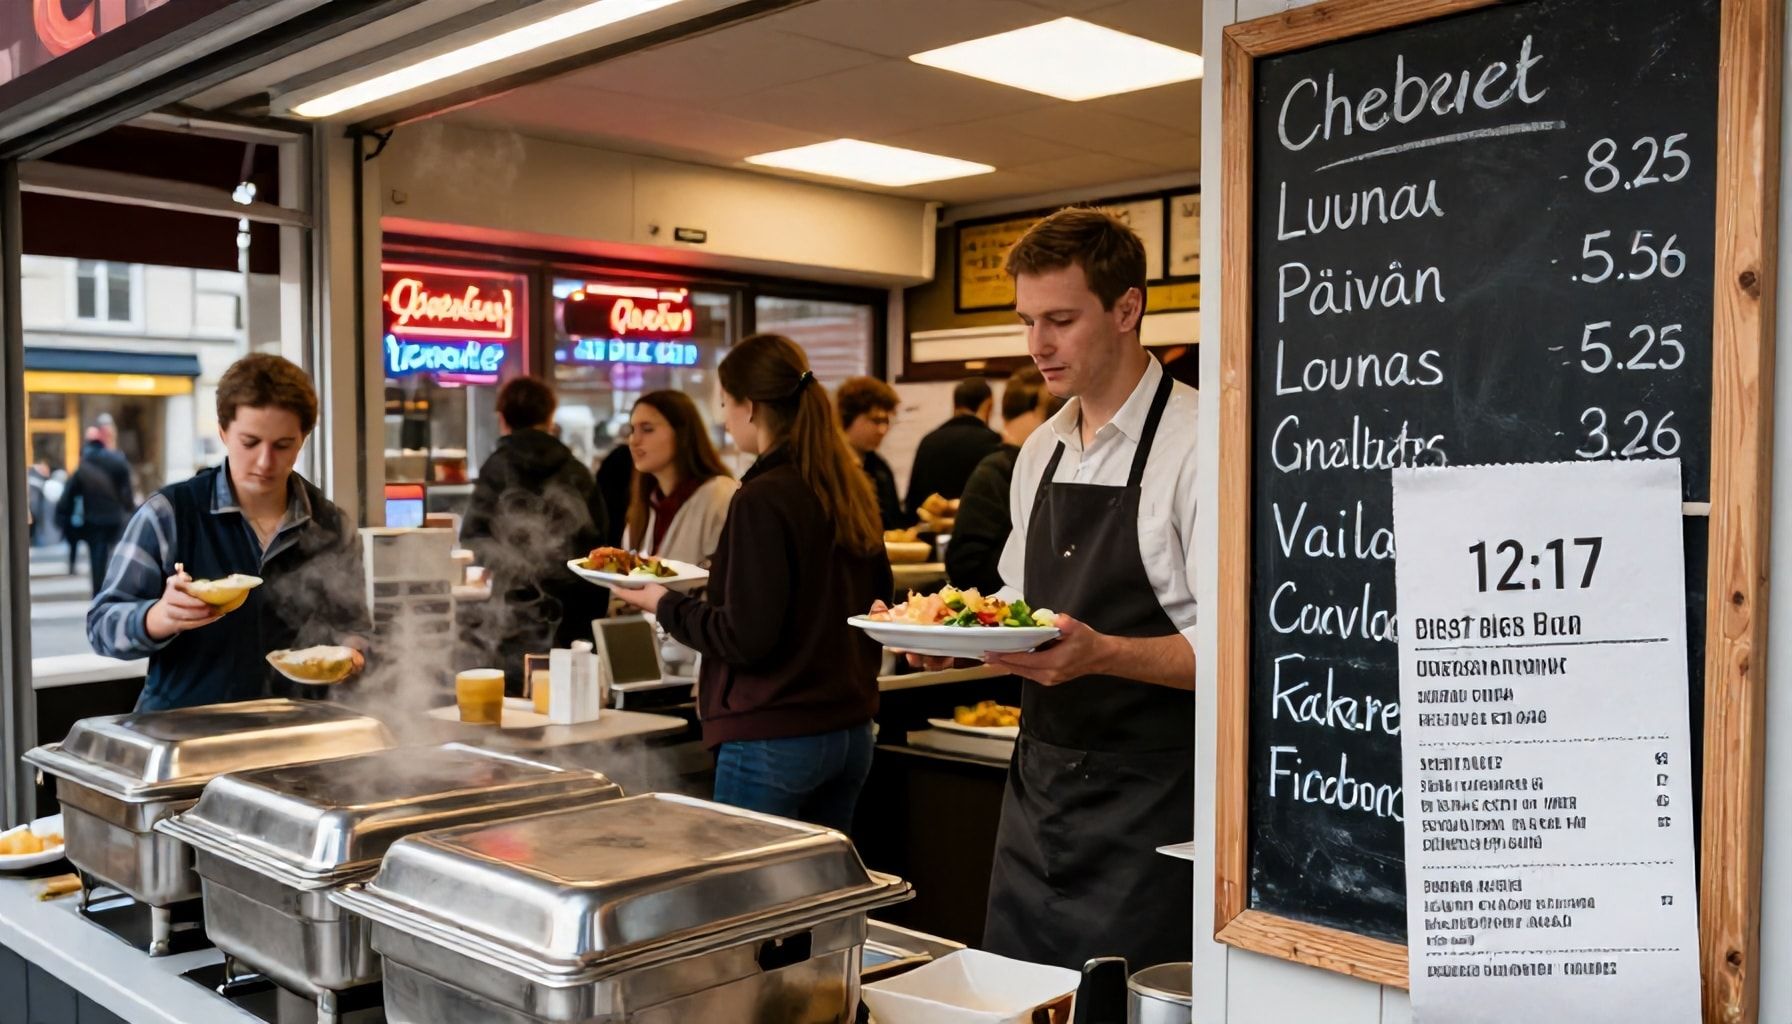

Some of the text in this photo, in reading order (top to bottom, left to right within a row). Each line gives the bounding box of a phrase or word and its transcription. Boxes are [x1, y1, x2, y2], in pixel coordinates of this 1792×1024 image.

[1584, 132, 1691, 194] 8.25
[1275, 320, 1686, 396] Lounas 5.25
[1575, 406, 1682, 458] 3.26
[1468, 536, 1603, 593] 12:17
